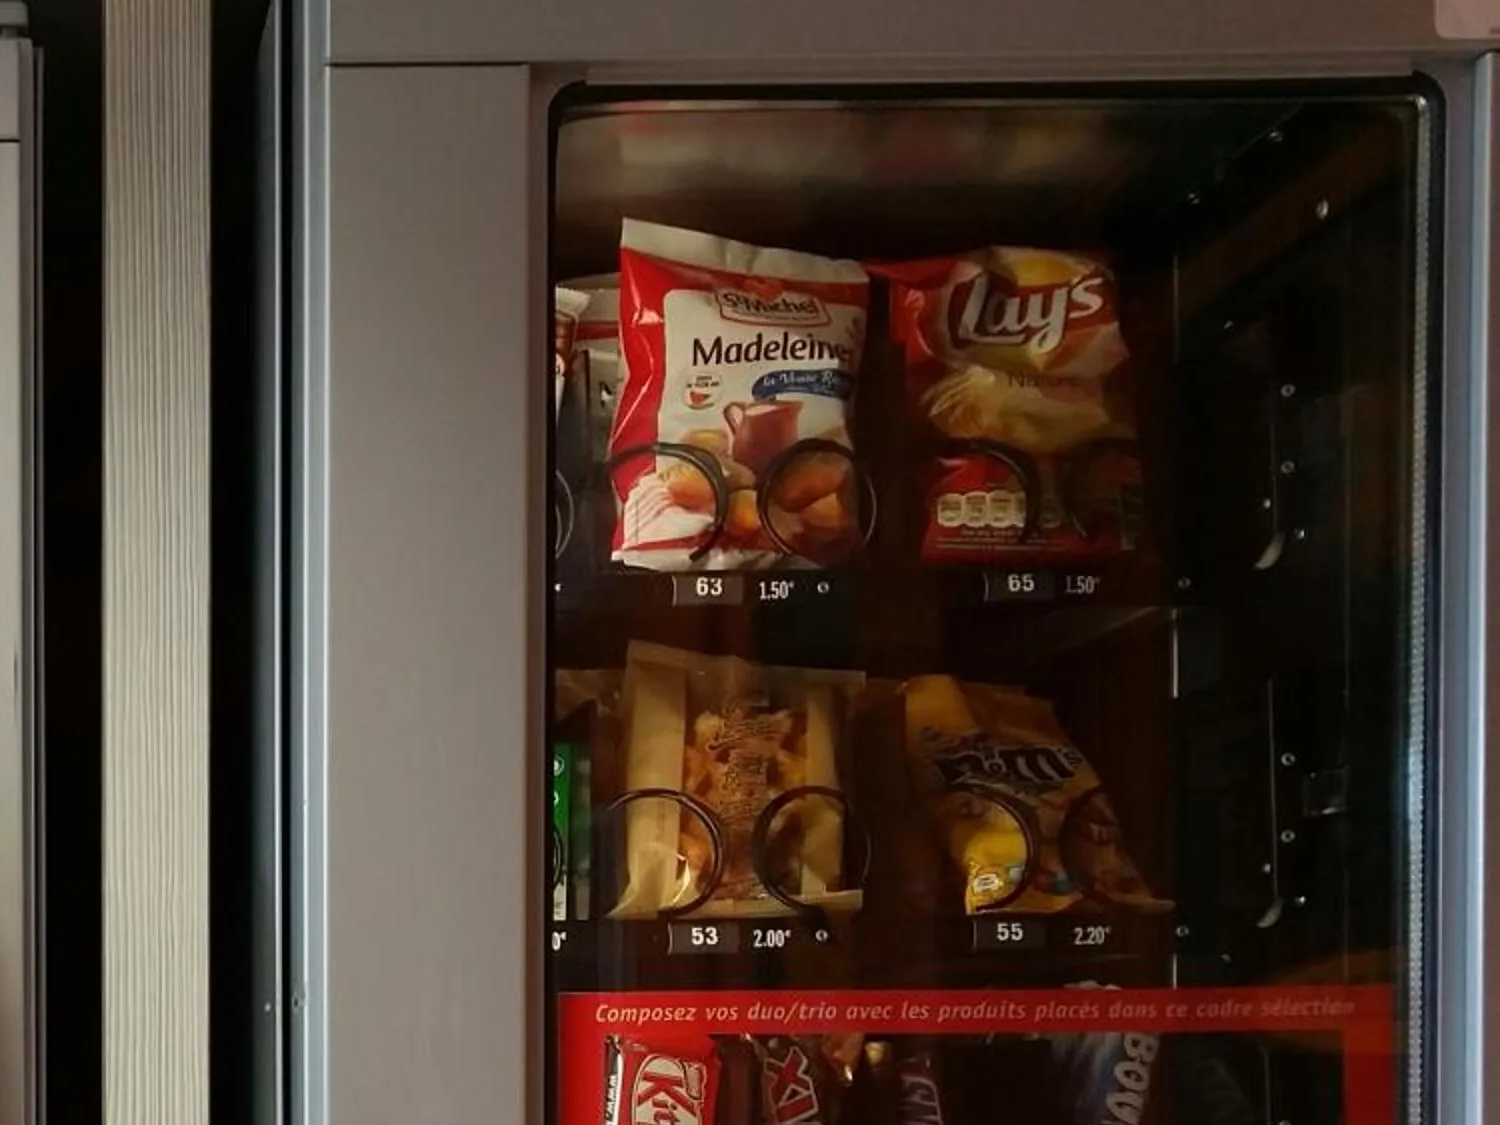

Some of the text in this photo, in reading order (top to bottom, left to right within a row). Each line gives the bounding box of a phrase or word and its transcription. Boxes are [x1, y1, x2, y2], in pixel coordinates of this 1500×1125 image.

[696, 577, 722, 595] 63
[1008, 574, 1035, 592] 65
[691, 927, 718, 945] 53
[997, 923, 1024, 941] 55
[595, 999, 1354, 1025] Composez vos duo/trio avec les produits placés dans ce cadre sélection
